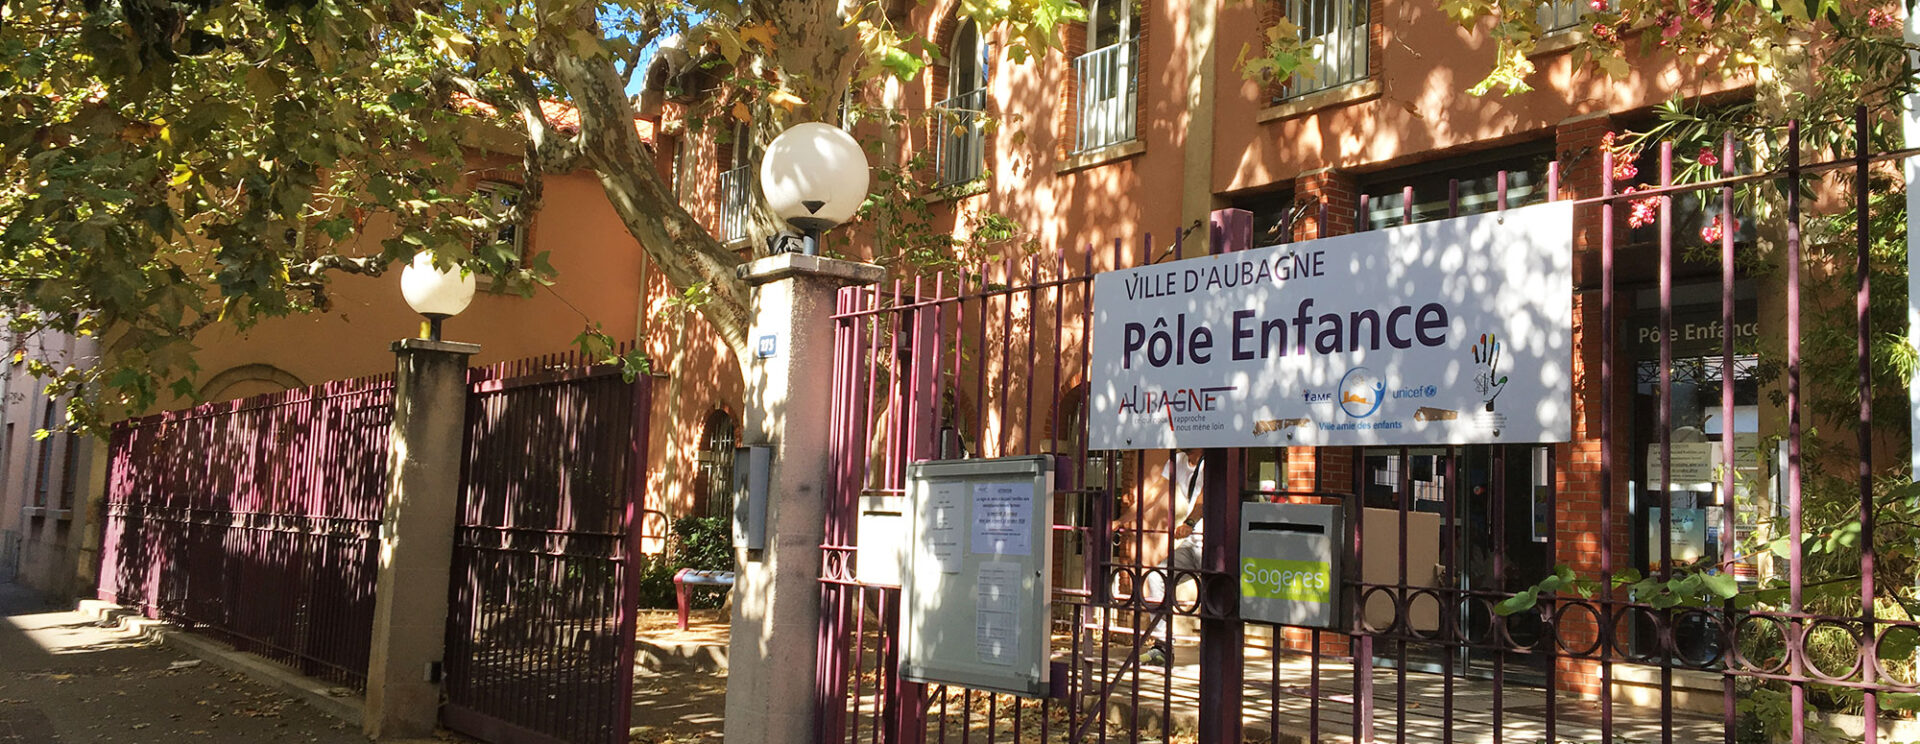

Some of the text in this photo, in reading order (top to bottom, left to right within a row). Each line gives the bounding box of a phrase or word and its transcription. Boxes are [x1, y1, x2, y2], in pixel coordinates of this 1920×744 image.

[1125, 251, 1325, 301] VILLE D'AUBAGNE
[1123, 297, 1449, 370] Pôle Enfance
[1639, 325, 1679, 343] Pôe
[1392, 385, 1423, 399] unicef
[1118, 385, 1238, 431] AUBAGNE
[1174, 414, 1206, 424] rapproche
[1176, 424, 1191, 432] nous
[1211, 422, 1225, 430] loin
[1319, 419, 1402, 430] Ville amie des enfants
[1243, 562, 1325, 594] Sogeres
